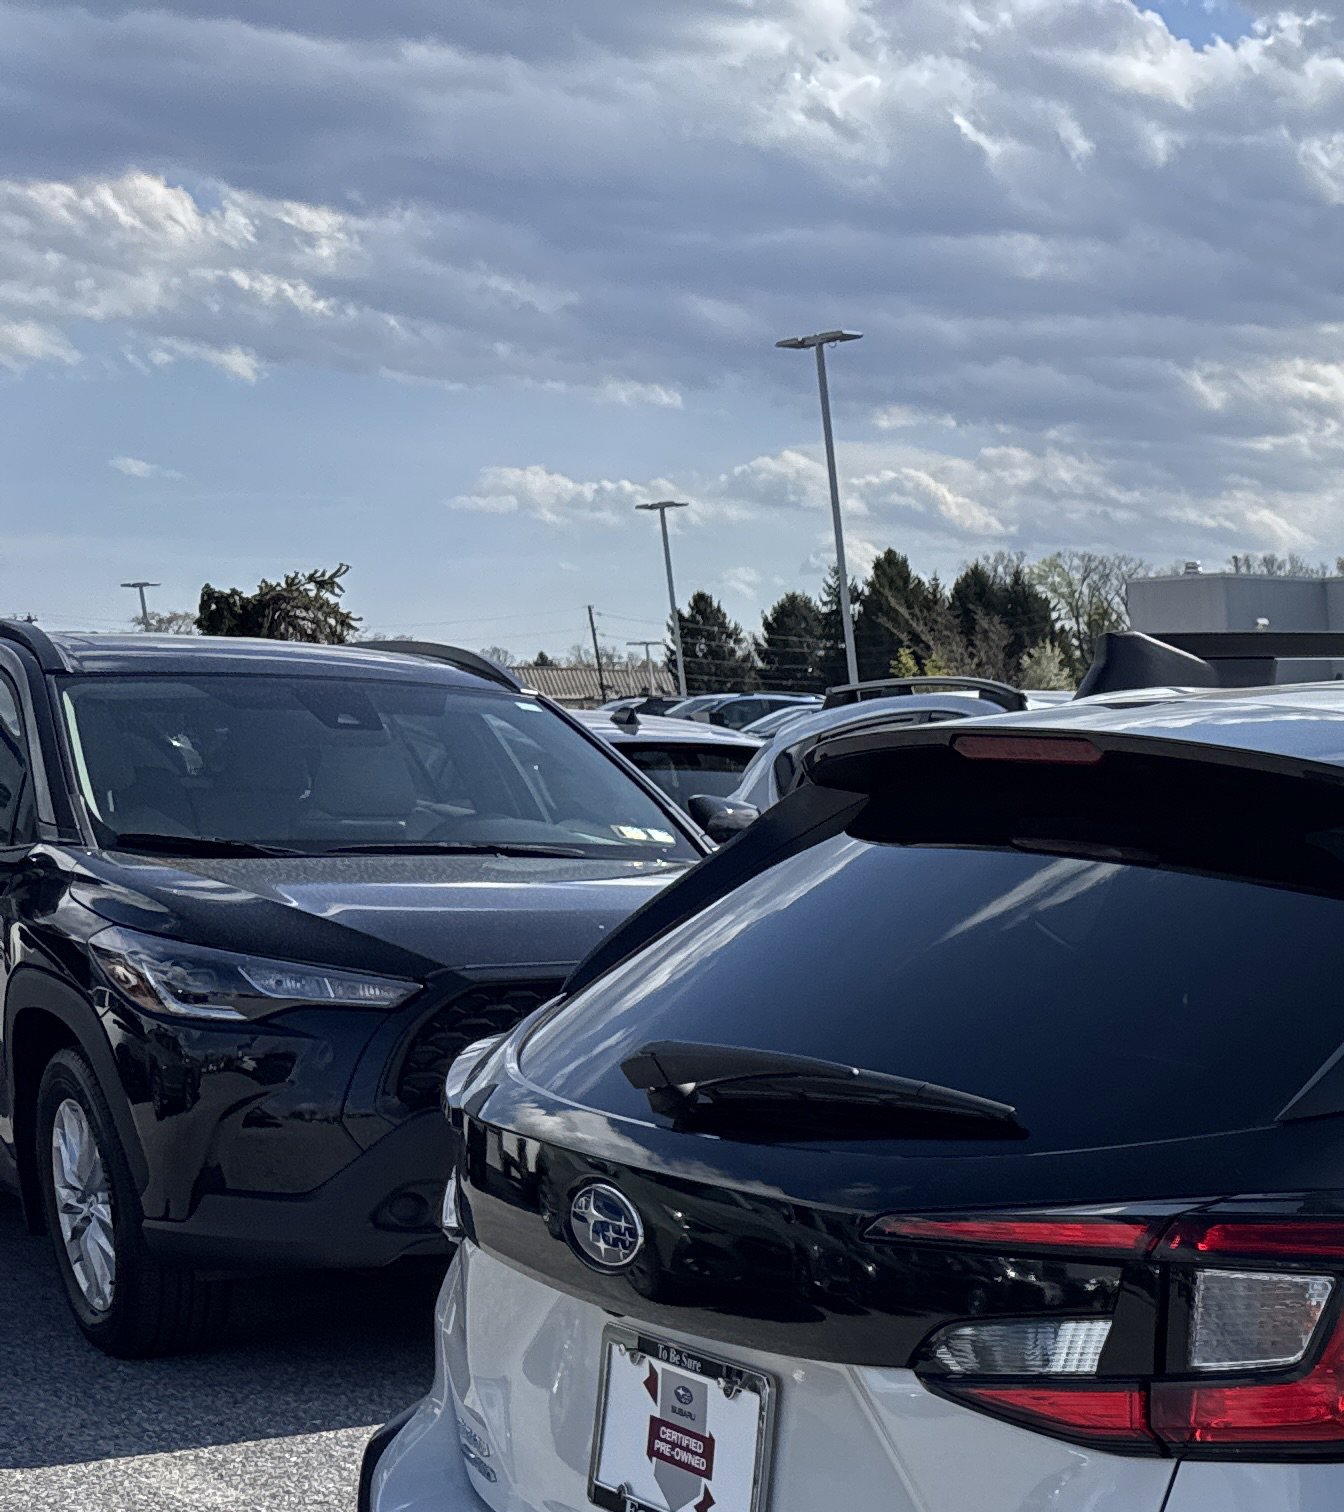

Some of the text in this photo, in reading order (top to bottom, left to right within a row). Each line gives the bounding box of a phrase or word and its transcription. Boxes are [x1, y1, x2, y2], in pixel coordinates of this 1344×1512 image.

[657, 1344, 703, 1372] To Be Sure
[670, 1404, 697, 1422] SUBARU
[659, 1426, 704, 1454] CERTIFIED
[653, 1439, 707, 1471] PRE-OWNED
